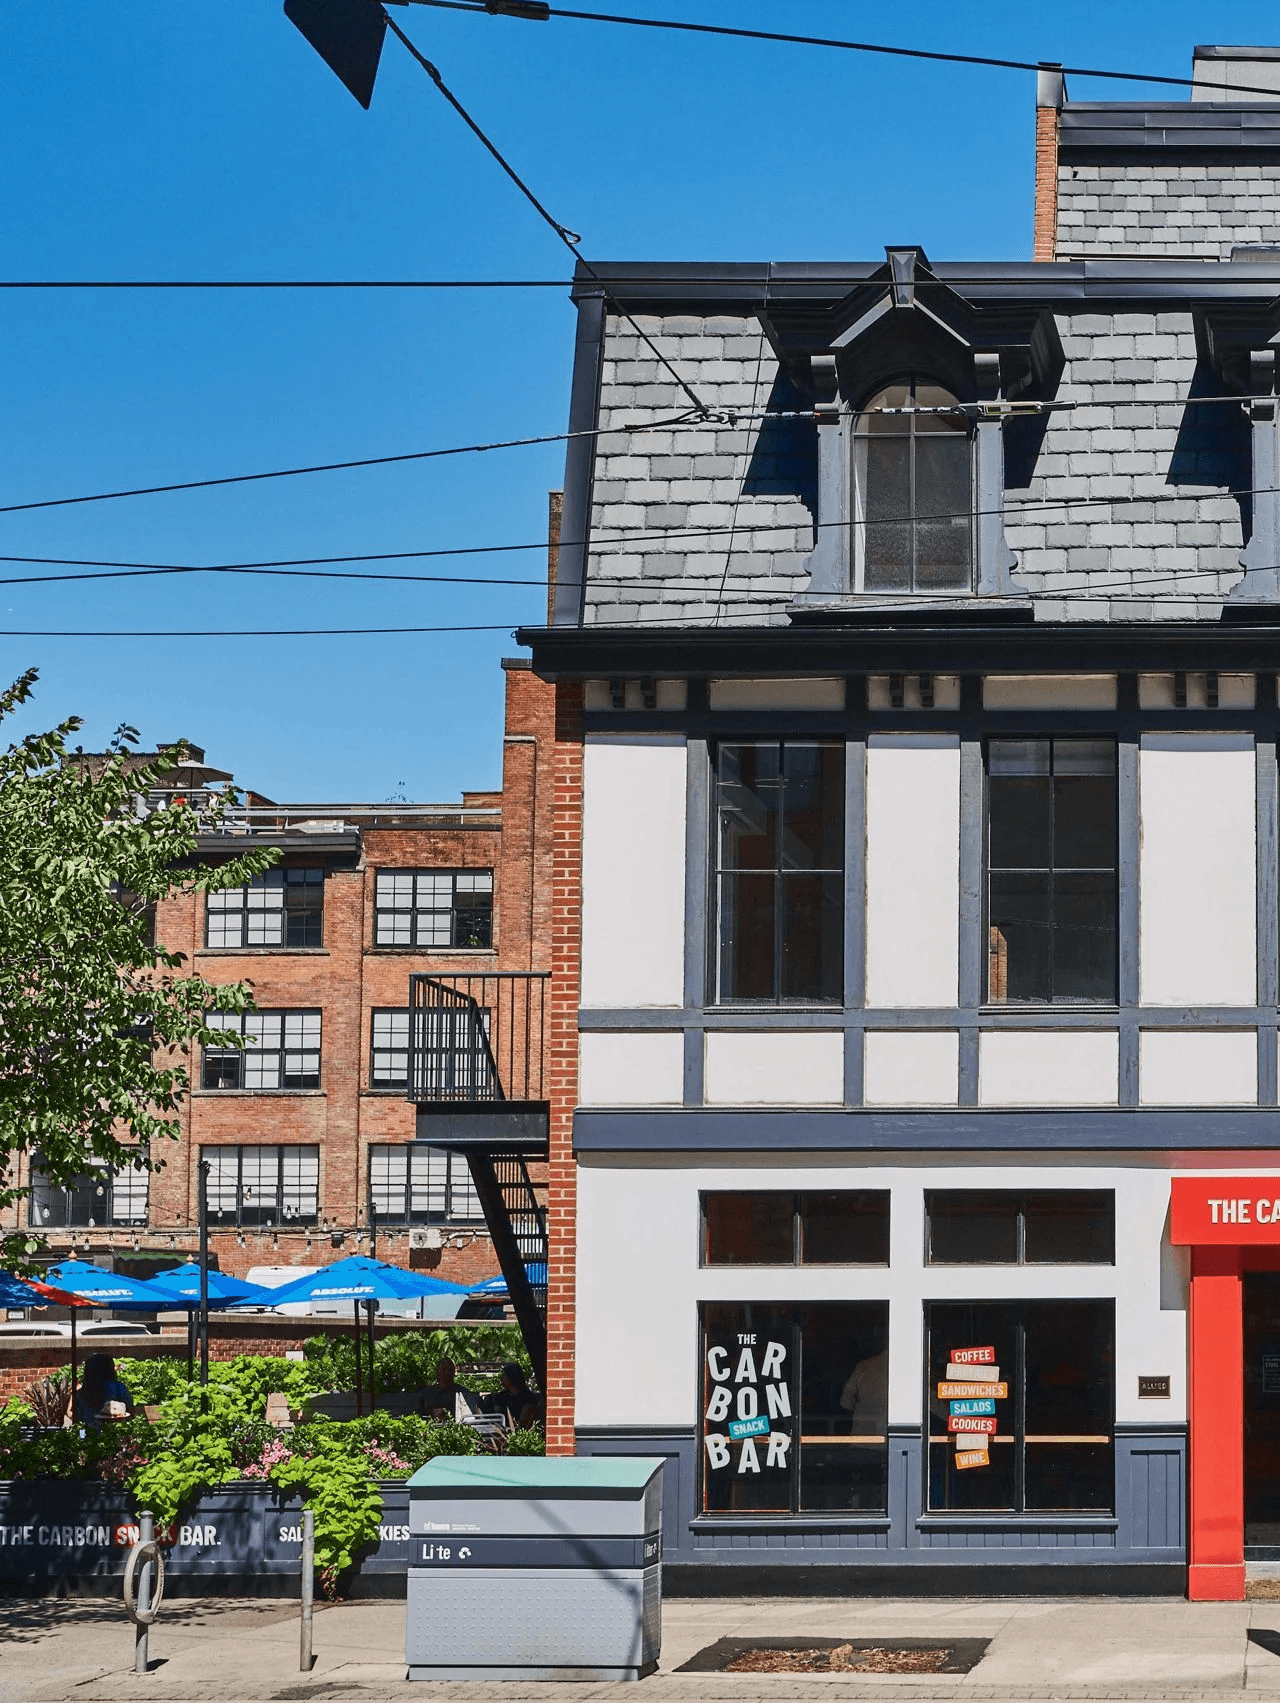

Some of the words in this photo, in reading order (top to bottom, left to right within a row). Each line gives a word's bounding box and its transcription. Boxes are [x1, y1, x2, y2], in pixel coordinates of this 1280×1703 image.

[1207, 1198, 1251, 1224] THE
[737, 1333, 757, 1345] THE
[707, 1341, 787, 1383] CAR
[954, 1349, 991, 1363] COFFEE
[941, 1384, 1004, 1396] SANDWICHES
[705, 1381, 792, 1422] BON
[954, 1401, 992, 1414] SALADS
[733, 1419, 765, 1436] SNACK
[952, 1418, 993, 1431] COOKIES
[705, 1431, 790, 1474] BAR
[960, 1452, 985, 1466] WINE
[0, 1525, 34, 1546] THE
[38, 1525, 110, 1546] CARBON
[116, 1525, 173, 1544] SNCK
